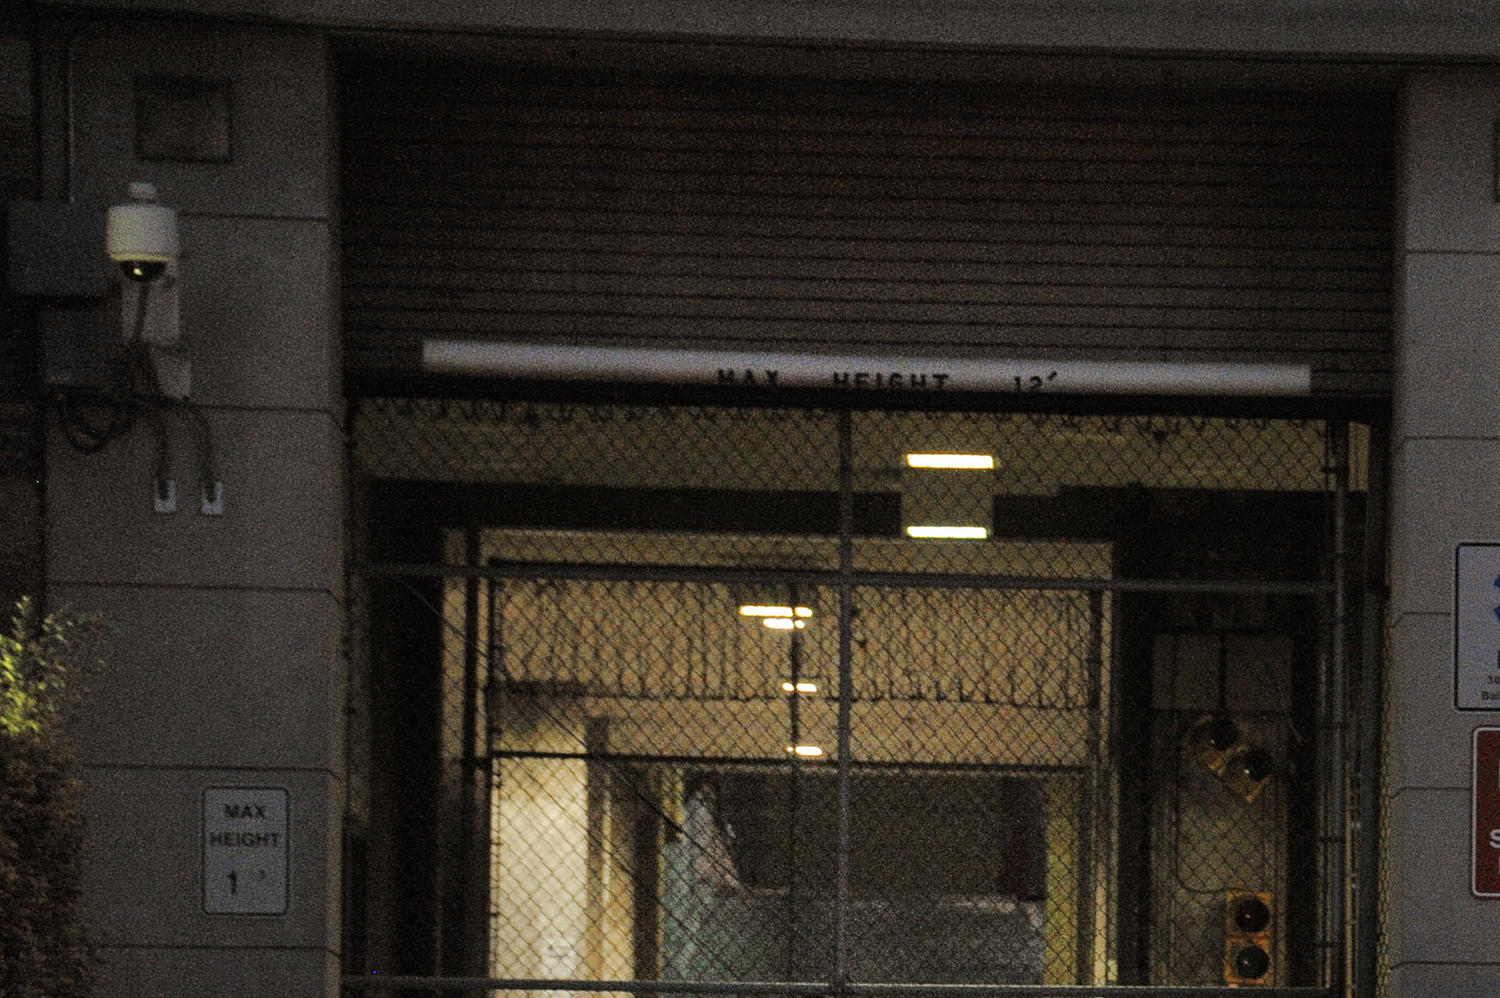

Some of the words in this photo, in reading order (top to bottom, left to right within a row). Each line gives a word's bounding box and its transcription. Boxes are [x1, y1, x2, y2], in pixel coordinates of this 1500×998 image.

[717, 368, 779, 387] MAX
[833, 371, 950, 389] HEIGHT
[224, 804, 265, 818] MAX
[210, 831, 279, 848] HEIGHT
